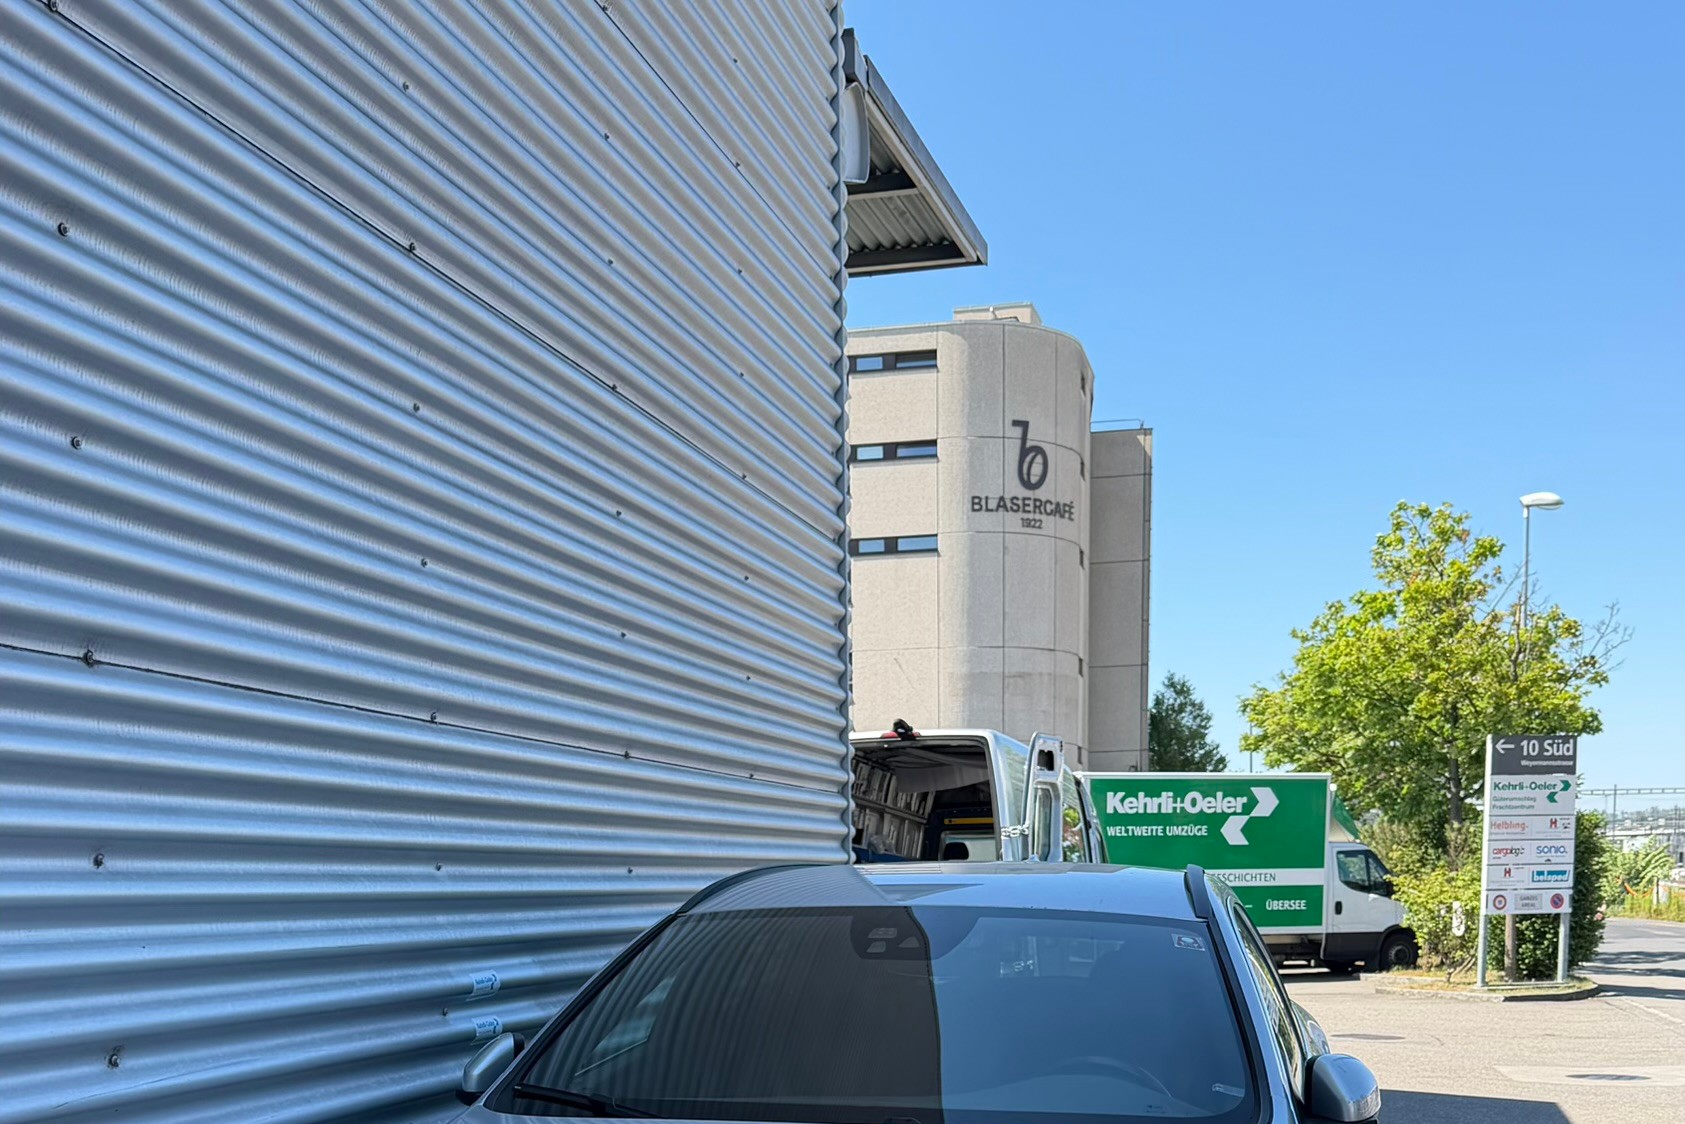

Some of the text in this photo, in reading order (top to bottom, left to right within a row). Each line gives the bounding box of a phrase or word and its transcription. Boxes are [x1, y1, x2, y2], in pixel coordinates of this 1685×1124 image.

[971, 496, 1074, 521] BLASERCAFÉ
[1020, 517, 1044, 530] 1922
[1520, 739, 1574, 756] 10 Süd
[1106, 791, 1248, 814] Kehrli+Oeler
[1106, 824, 1208, 836] WELTWEITE UMZÜGE
[1265, 899, 1307, 911] ÜBERSEE
